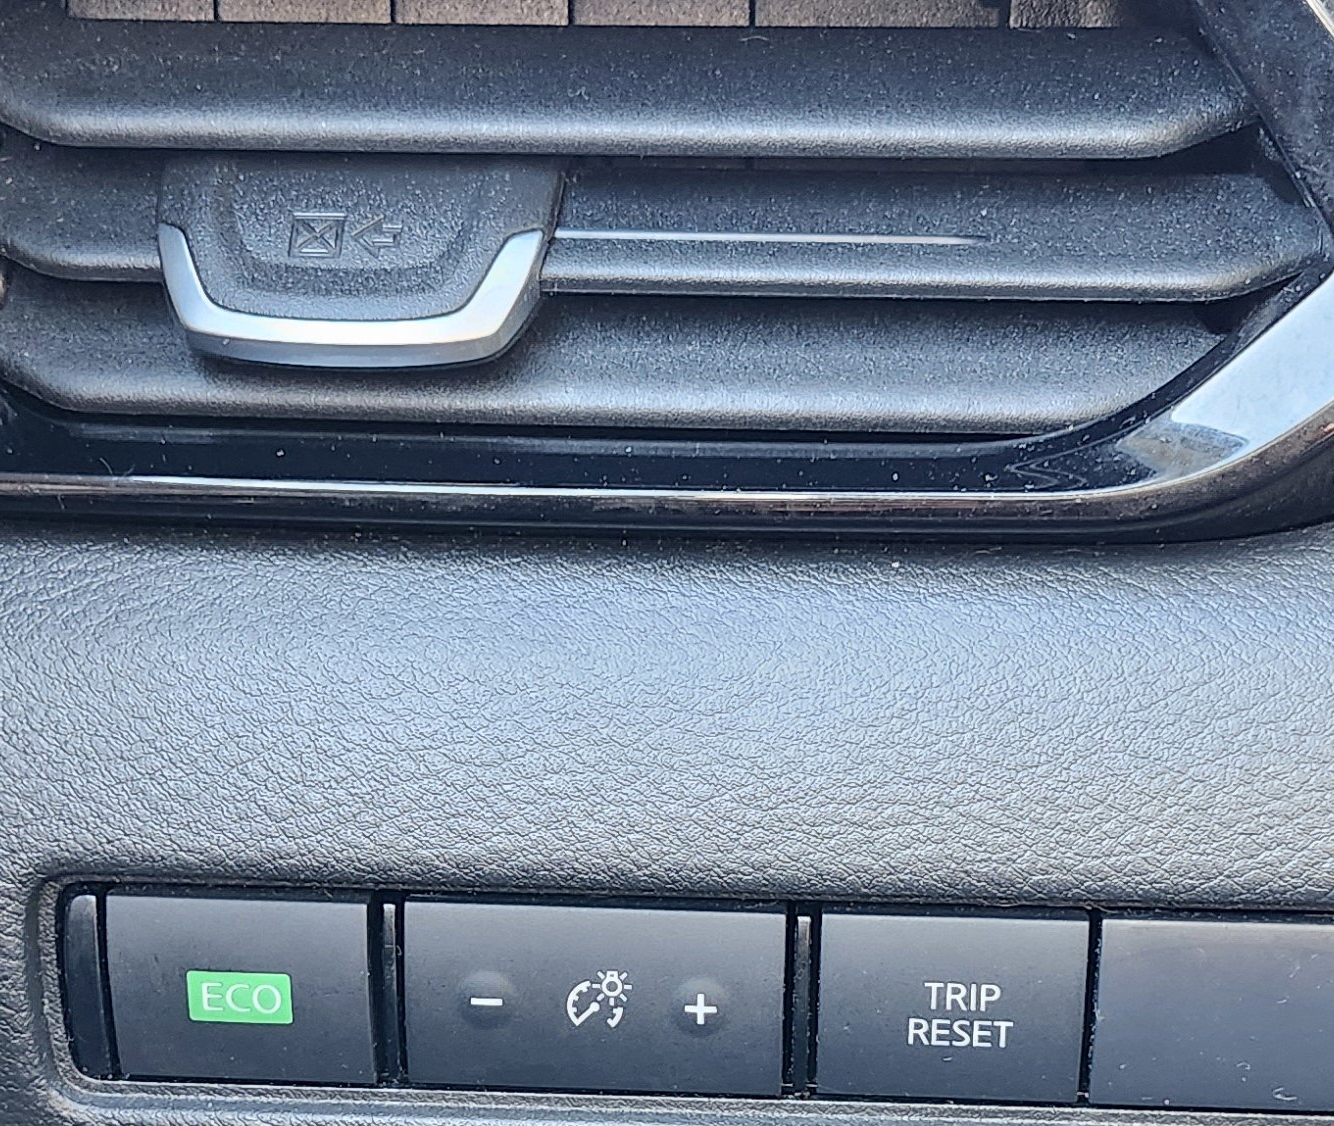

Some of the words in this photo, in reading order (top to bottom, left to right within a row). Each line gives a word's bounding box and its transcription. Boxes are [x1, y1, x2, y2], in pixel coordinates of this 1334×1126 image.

[201, 981, 282, 1014] ECO
[924, 982, 1002, 1012] TRIP
[907, 1017, 1014, 1048] RESET
